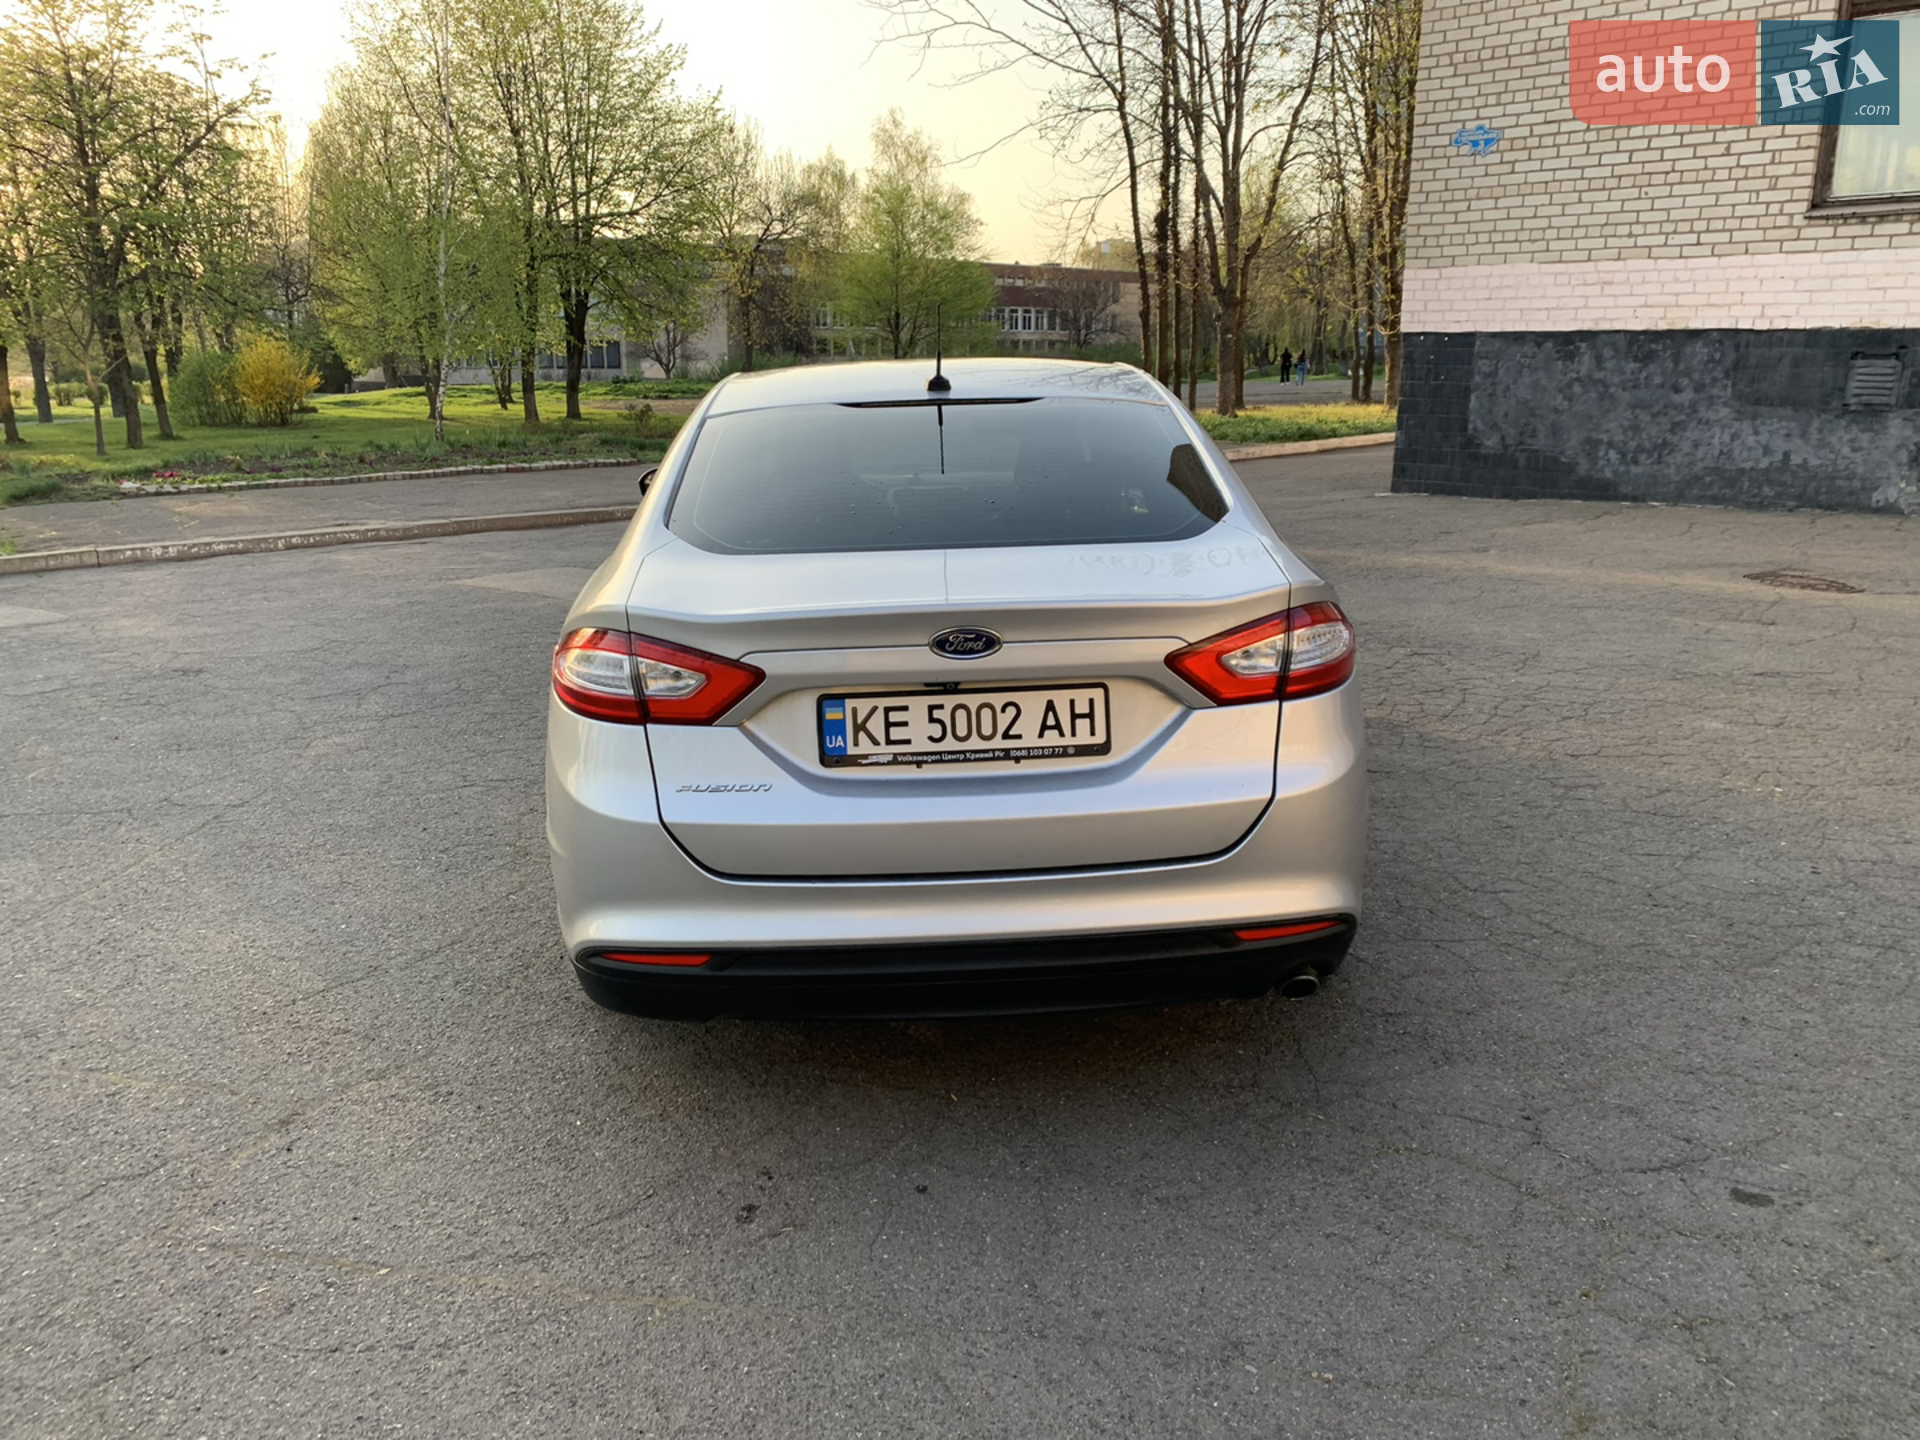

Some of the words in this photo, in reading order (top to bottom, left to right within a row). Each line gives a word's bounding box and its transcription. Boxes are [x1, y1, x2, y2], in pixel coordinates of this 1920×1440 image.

[945, 633, 986, 652] Ford
[851, 704, 912, 747] KE
[926, 701, 1023, 744] 5002
[1037, 697, 1096, 739] AH
[825, 735, 845, 749] UA
[896, 753, 941, 763] Volkswagen
[942, 752, 965, 761] Центр
[1029, 748, 1043, 757] 103
[1043, 747, 1053, 756] 07
[1054, 747, 1064, 755] 77
[675, 783, 773, 793] FUSION
